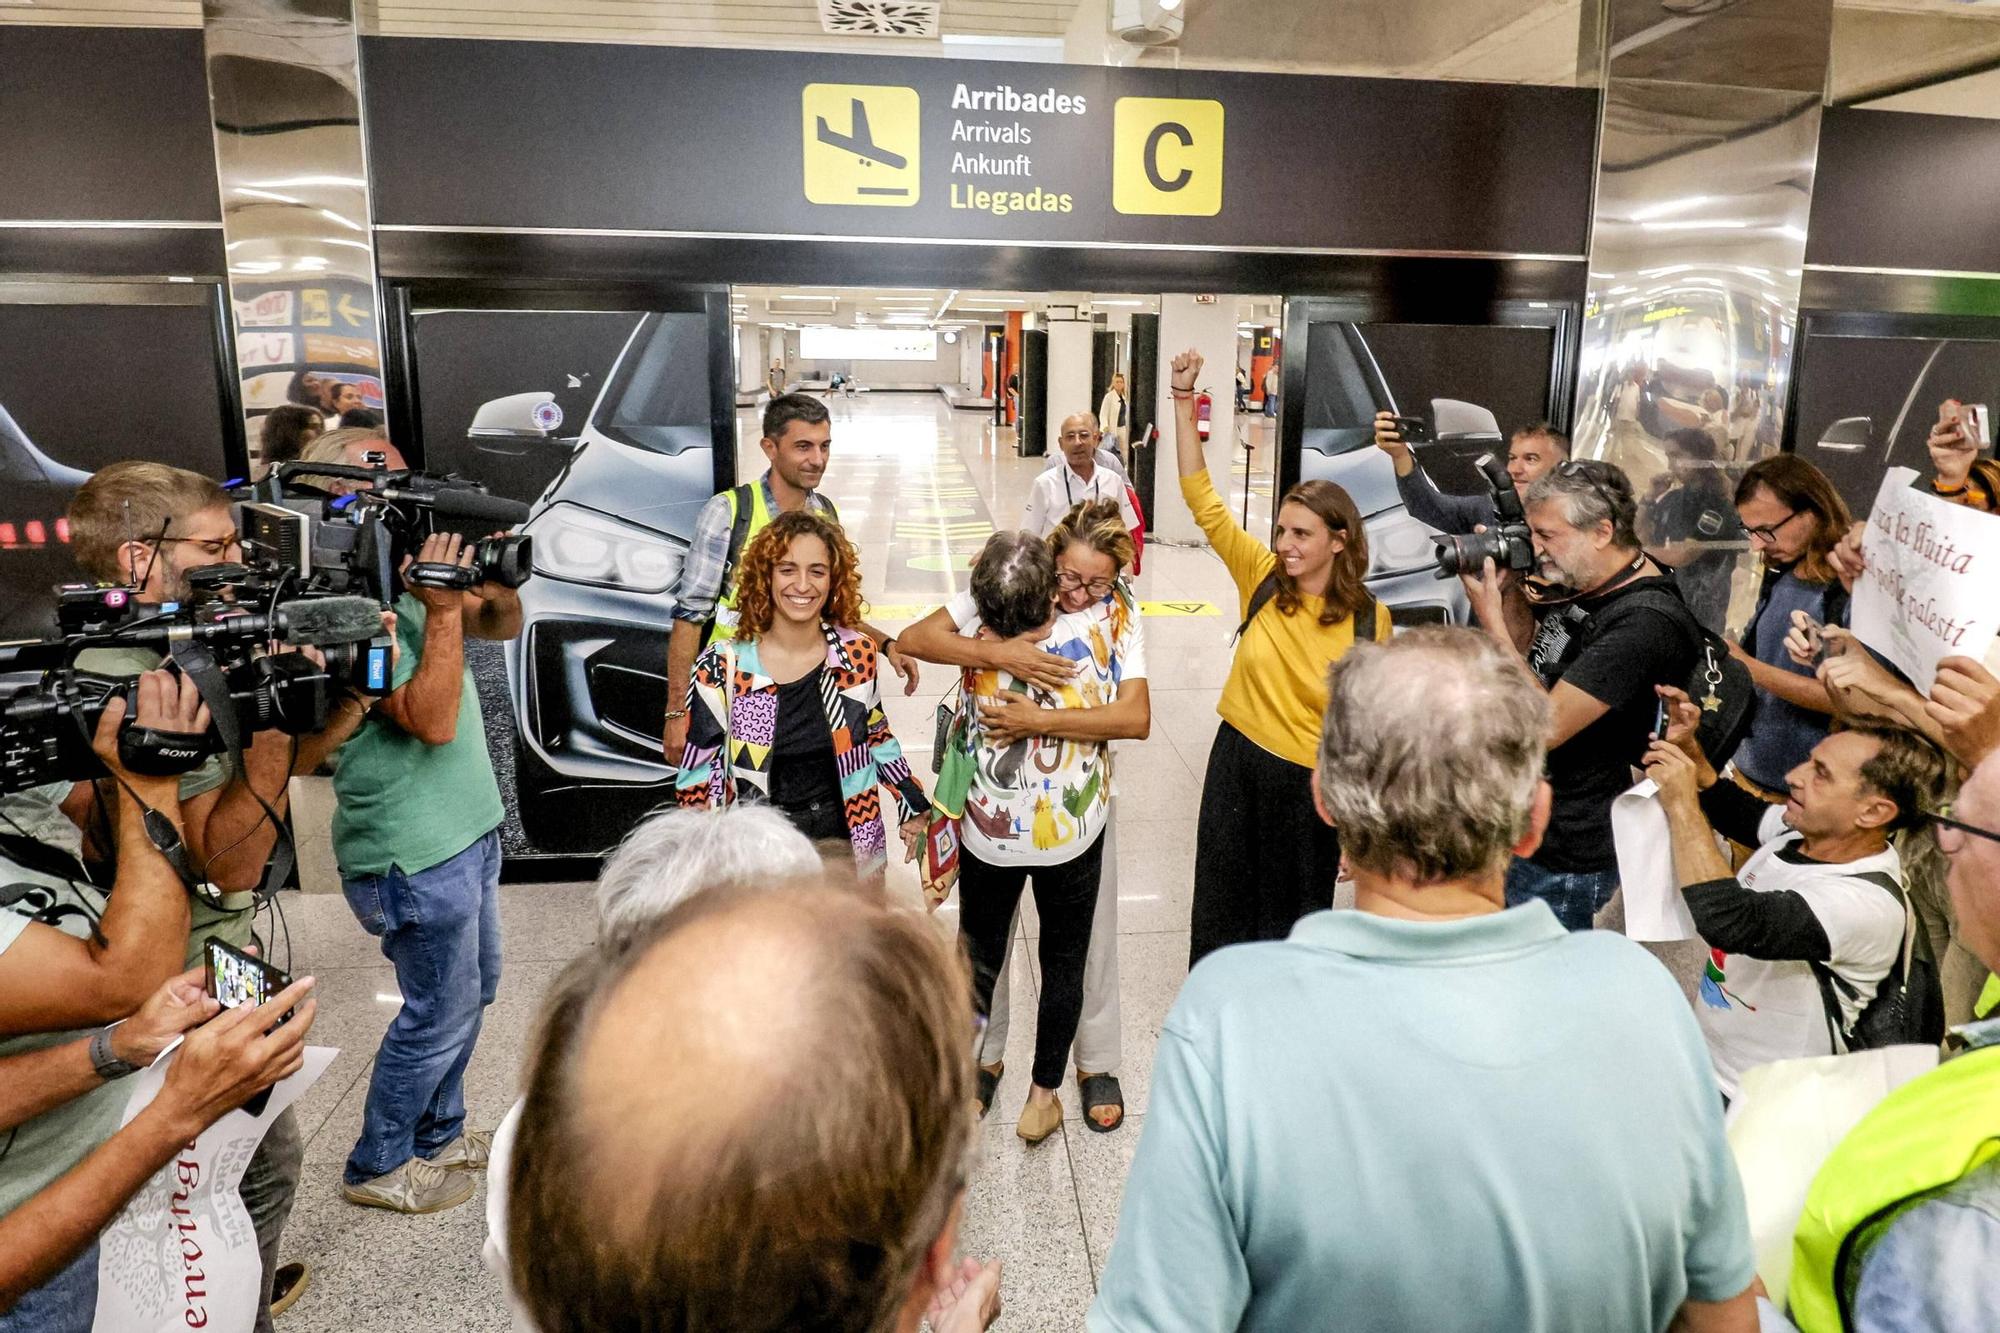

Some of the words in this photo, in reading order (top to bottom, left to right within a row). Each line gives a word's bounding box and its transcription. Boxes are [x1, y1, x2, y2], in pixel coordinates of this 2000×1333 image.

[951, 83, 1087, 115] Arribades
[951, 119, 1032, 144] Arrivals
[951, 151, 1032, 177] Ankunft
[1143, 121, 1194, 192] C
[950, 183, 1073, 216] Llegadas
[1895, 511, 1910, 546] la
[1909, 594, 1976, 648] palestí
[158, 747, 199, 758] SONY
[214, 1137, 243, 1249] MALLORCA
